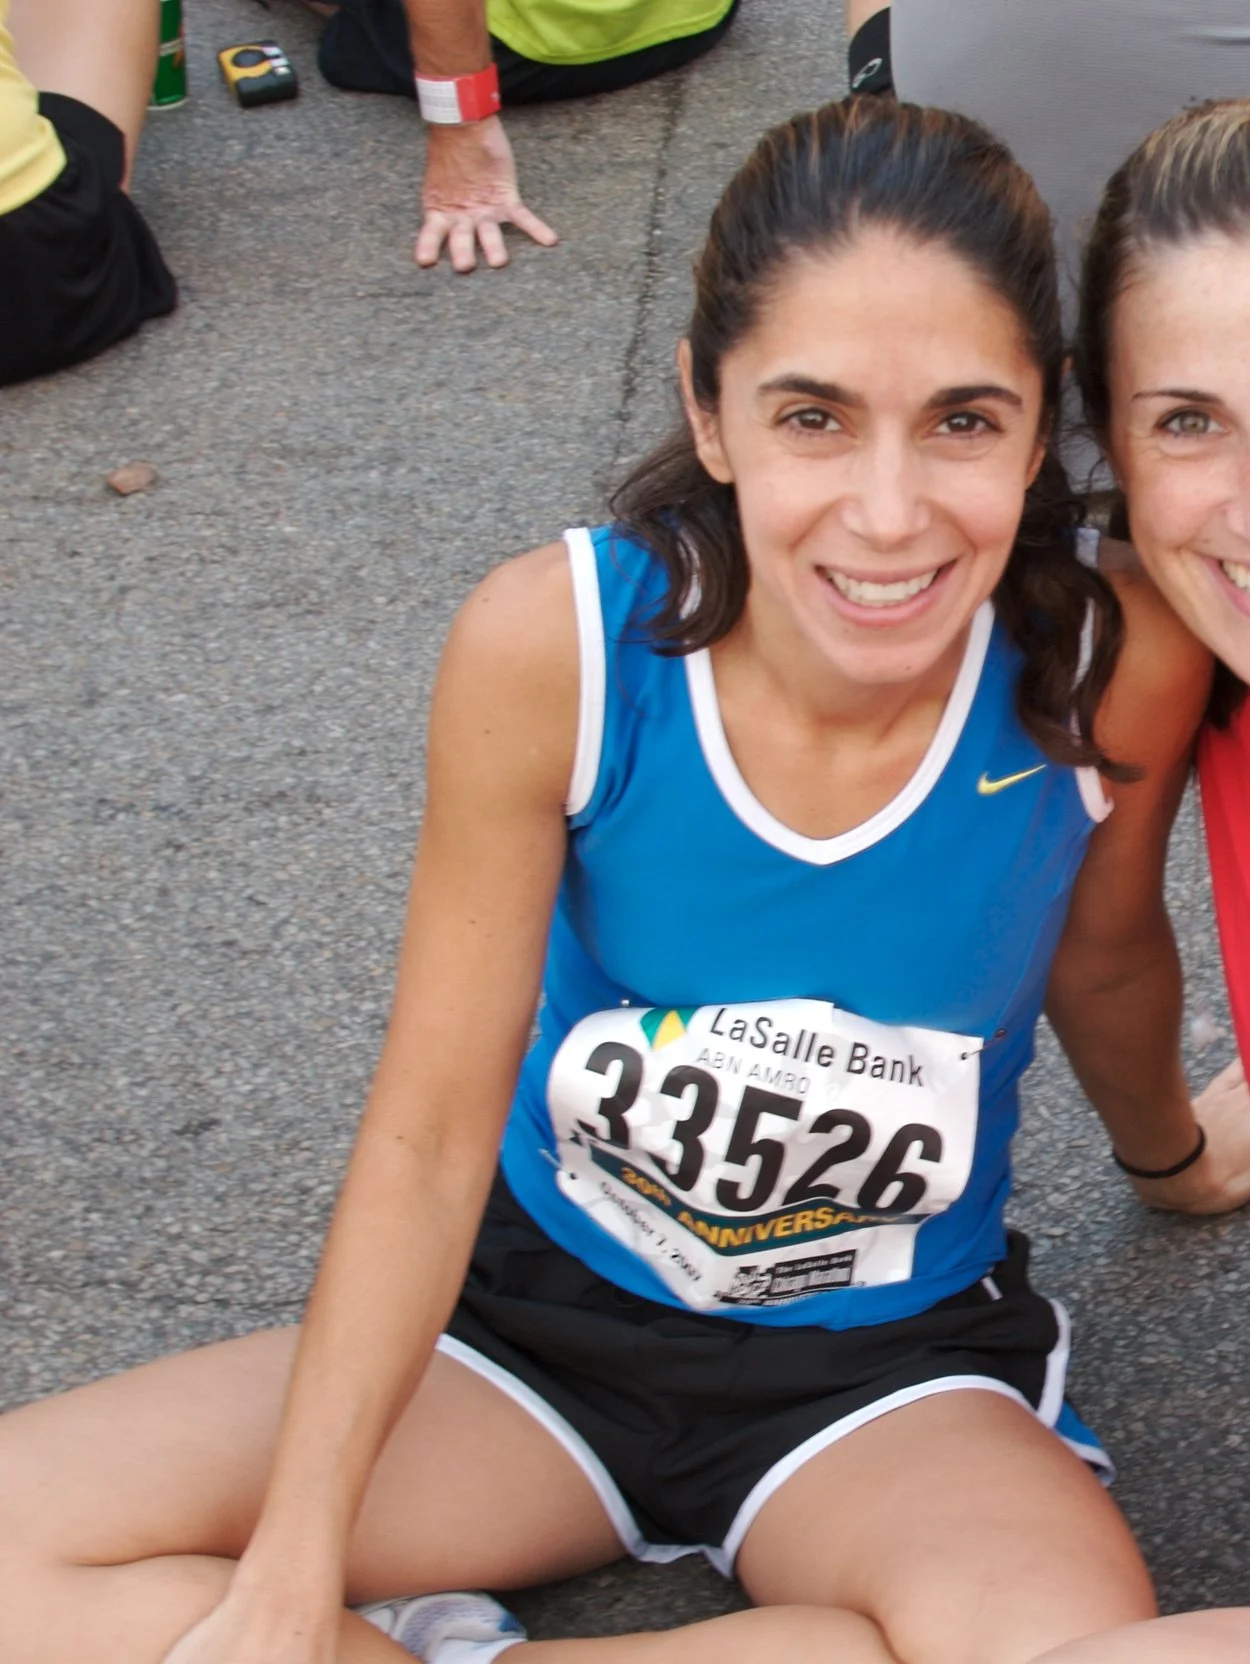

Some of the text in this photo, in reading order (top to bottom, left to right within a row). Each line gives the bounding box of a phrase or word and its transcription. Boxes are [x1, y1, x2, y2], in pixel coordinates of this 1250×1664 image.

[695, 1047, 811, 1095] ABN AMRO
[710, 1007, 925, 1088] LaSalle Bank
[577, 1041, 943, 1215] 33526
